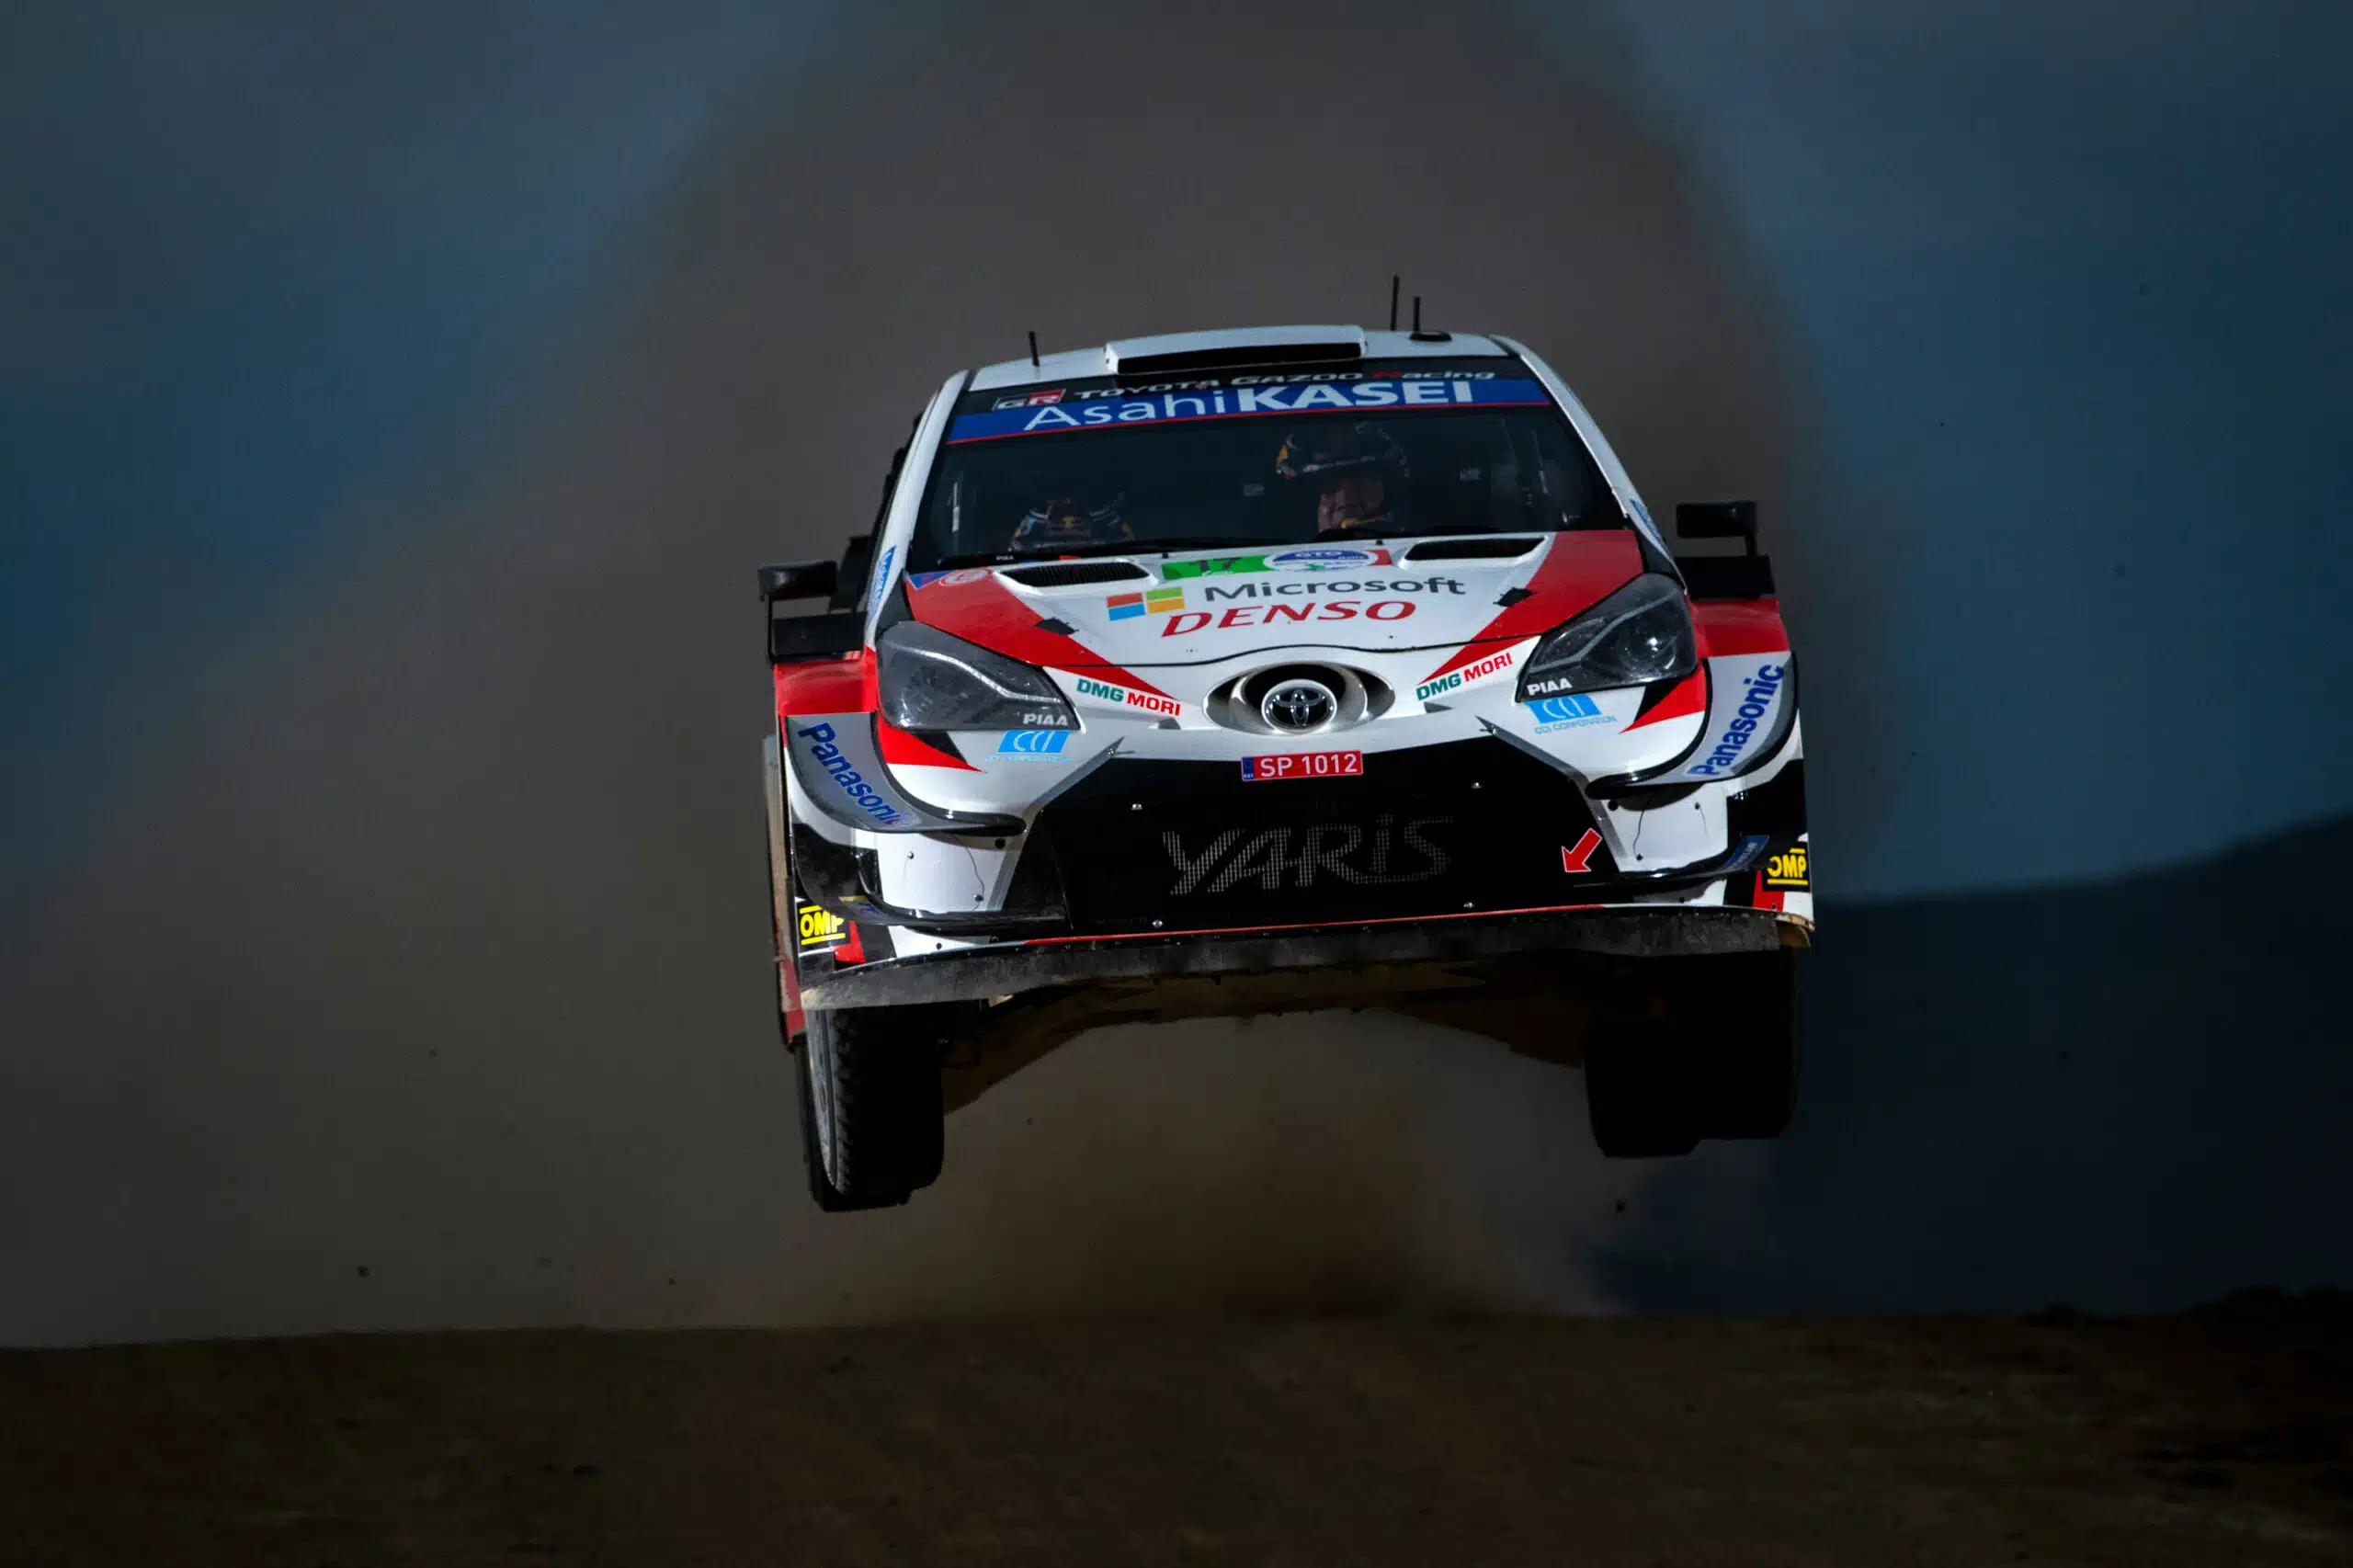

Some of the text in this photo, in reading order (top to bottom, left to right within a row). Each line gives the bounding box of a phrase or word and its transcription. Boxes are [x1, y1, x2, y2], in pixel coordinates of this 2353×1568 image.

[996, 370, 1495, 410] GR TOYOTA GAZOO Racing
[1188, 556, 1243, 573] 17
[1205, 576, 1467, 602] Microsoft
[1161, 600, 1416, 637] DENSO
[1415, 653, 1513, 702] DMG MORI
[1526, 677, 1574, 697] PIAA
[1076, 677, 1181, 717] DMG MORI
[1022, 712, 1069, 726] PIAA
[1687, 665, 1785, 776] Panasonic
[798, 722, 912, 825] Panasonic
[1260, 753, 1358, 778] SP 1012
[1767, 854, 1807, 878] OMP
[800, 910, 845, 937] OMP
